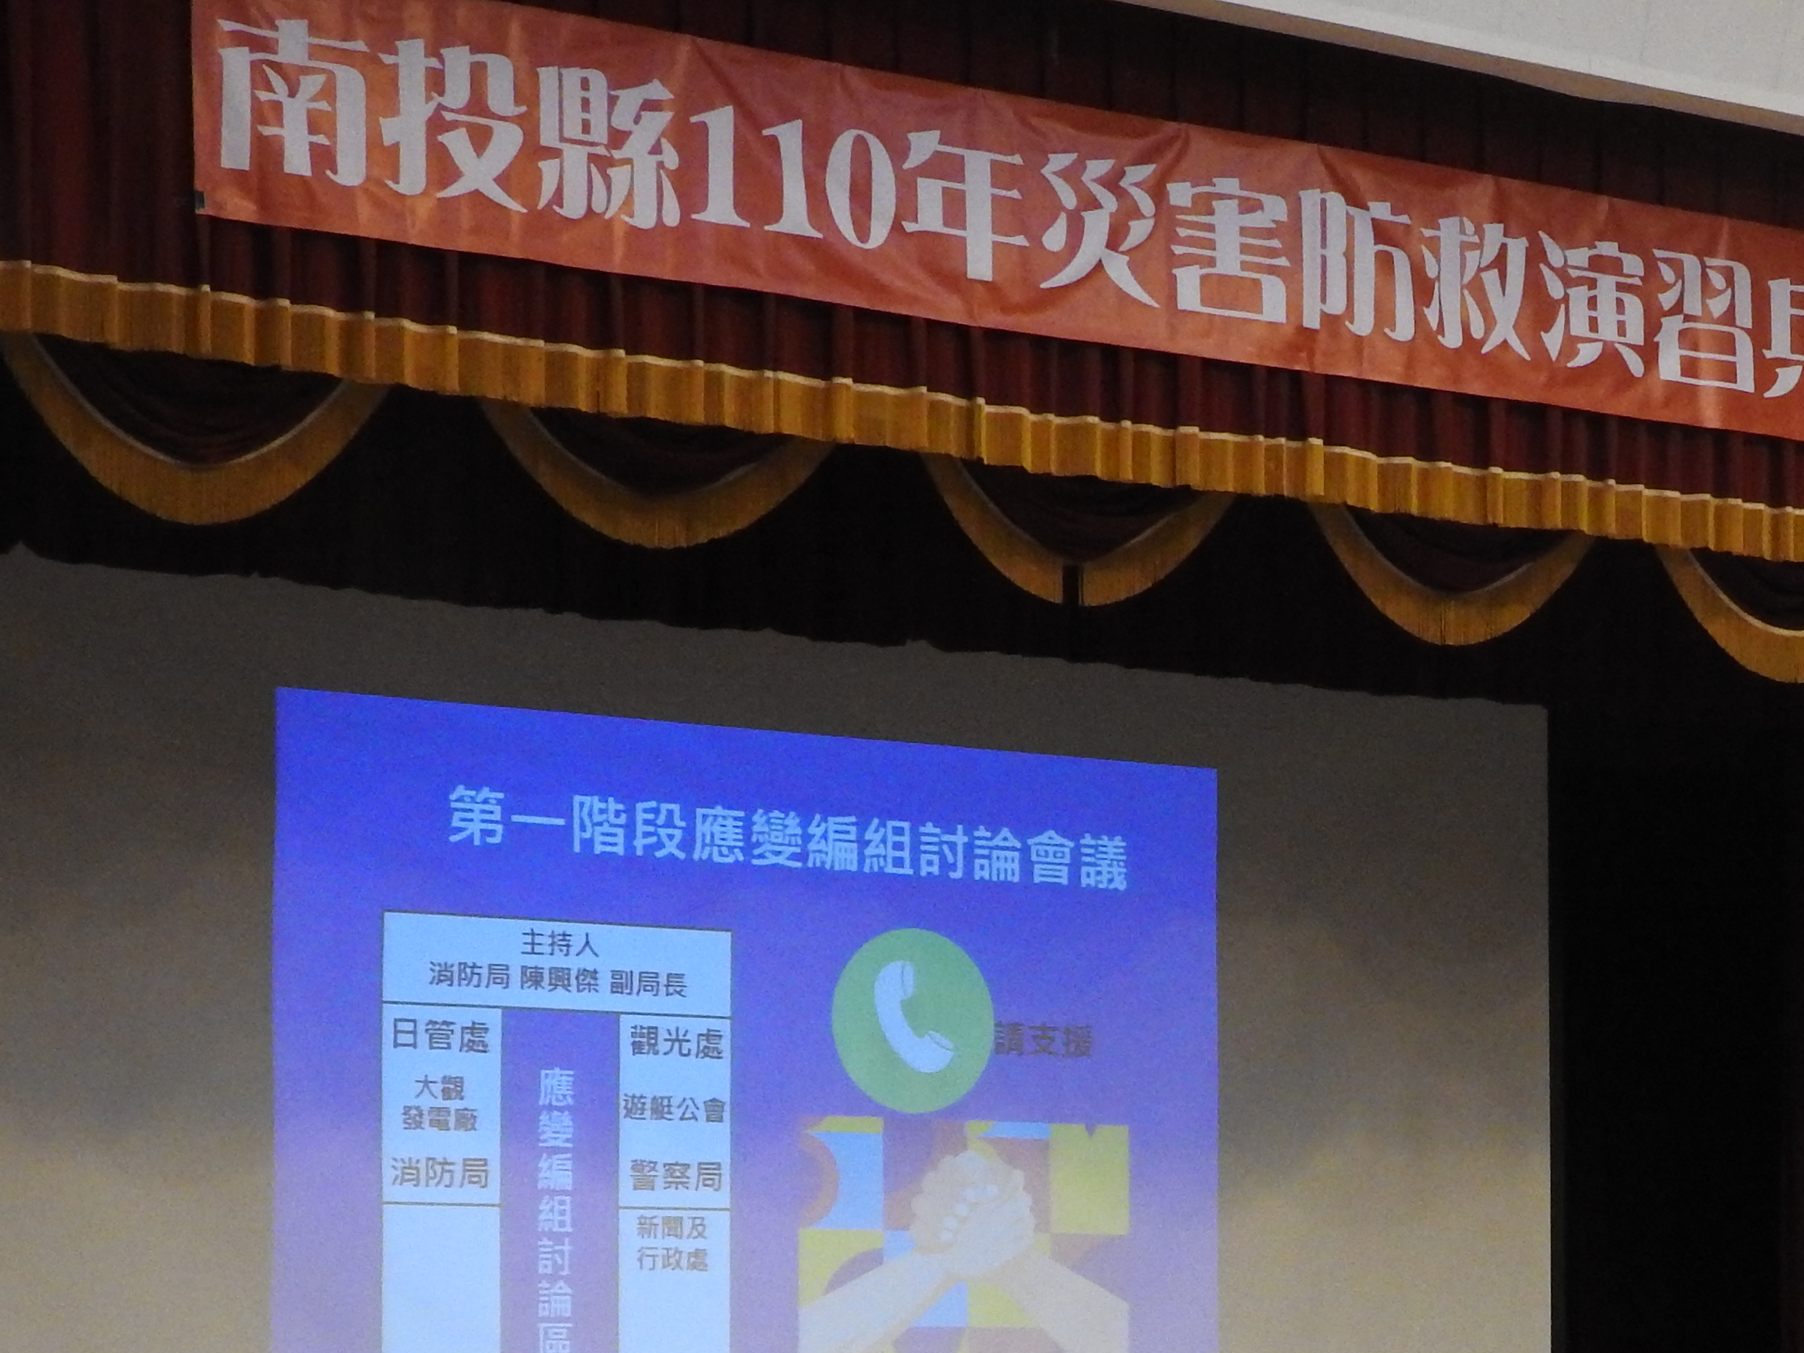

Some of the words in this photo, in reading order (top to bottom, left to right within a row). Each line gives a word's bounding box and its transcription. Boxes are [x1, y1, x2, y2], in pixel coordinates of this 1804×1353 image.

[448, 784, 1129, 891] 第一階段應變編組討論會議
[520, 928, 600, 958] 主持人
[428, 960, 511, 990] 消防局
[609, 969, 689, 999] 副局長
[391, 1018, 491, 1055] 日管處
[629, 1024, 725, 1060] 觀光處
[992, 1021, 1094, 1059] 請支援
[414, 1074, 466, 1102] 大觀
[401, 1106, 478, 1133] 發電廠
[390, 1156, 490, 1190] 消防局
[629, 1158, 723, 1193] 警察局
[636, 1214, 708, 1241] 新聞及
[636, 1246, 709, 1273] 行政處
